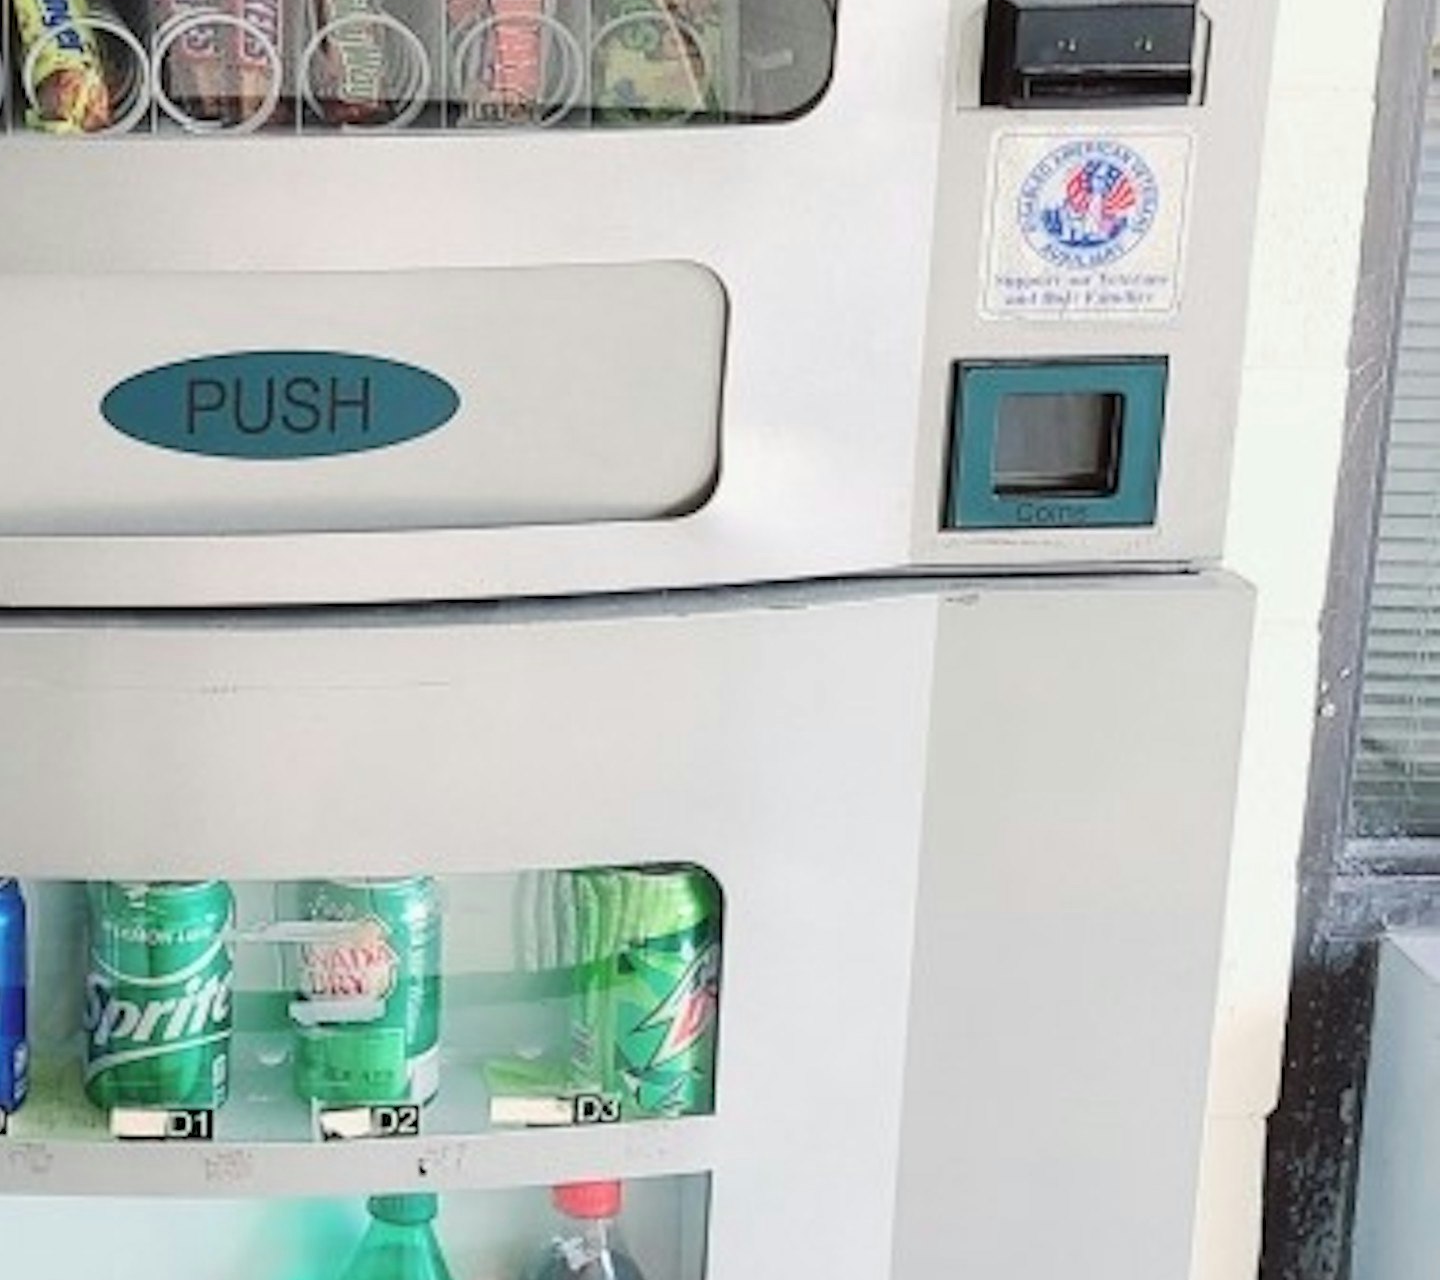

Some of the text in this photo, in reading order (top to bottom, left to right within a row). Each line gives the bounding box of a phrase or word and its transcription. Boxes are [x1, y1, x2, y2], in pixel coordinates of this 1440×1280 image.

[186, 375, 372, 436] PUSH
[167, 1111, 211, 1137] D1
[377, 1109, 417, 1134] D2
